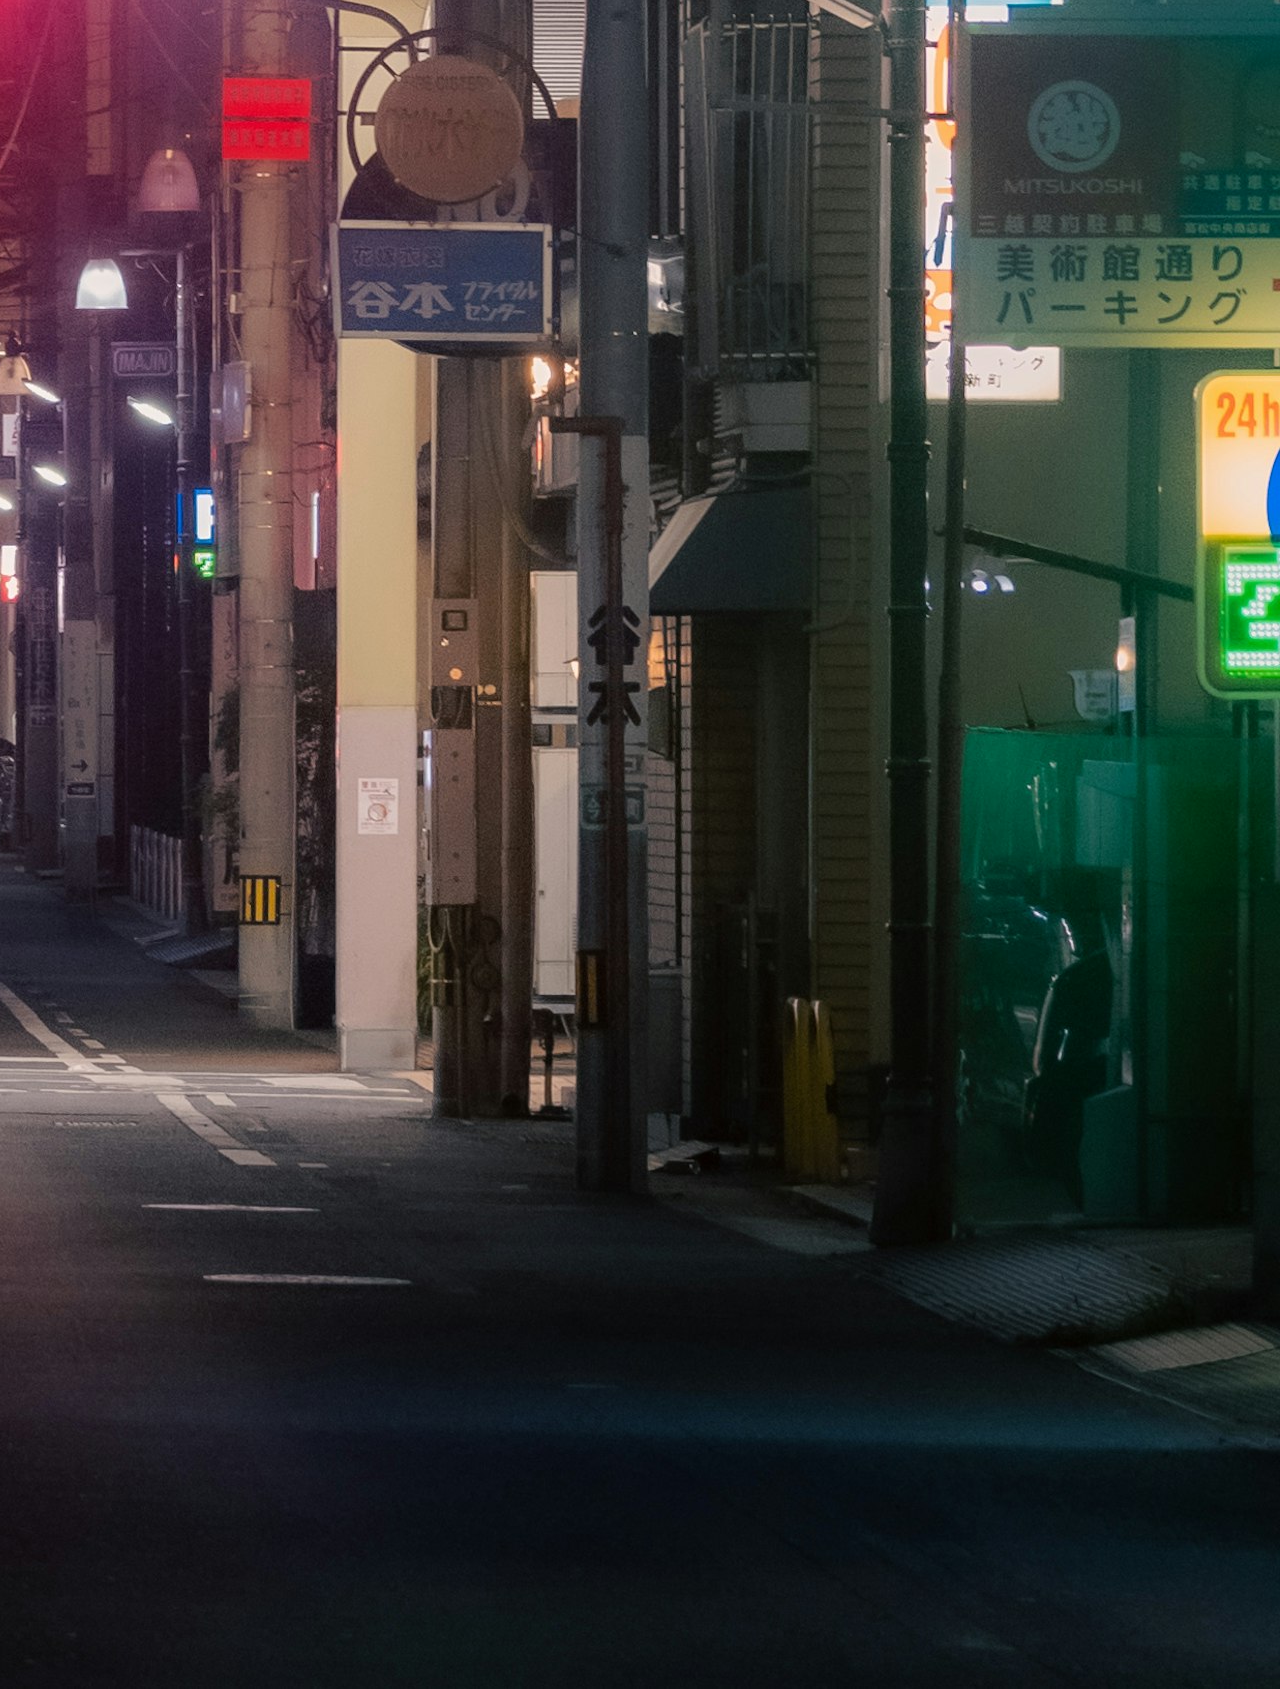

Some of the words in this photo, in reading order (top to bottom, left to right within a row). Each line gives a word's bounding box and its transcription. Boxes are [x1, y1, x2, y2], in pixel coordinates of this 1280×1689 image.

[1002, 178, 1144, 195] MITSUKOSHI
[978, 213, 1164, 235] 三越契約駐車場
[996, 243, 1245, 282] 美術館通り
[347, 279, 455, 320] 谷本
[996, 287, 1248, 326] パーキング
[465, 302, 527, 322] センター
[117, 351, 171, 374] IMAJIN
